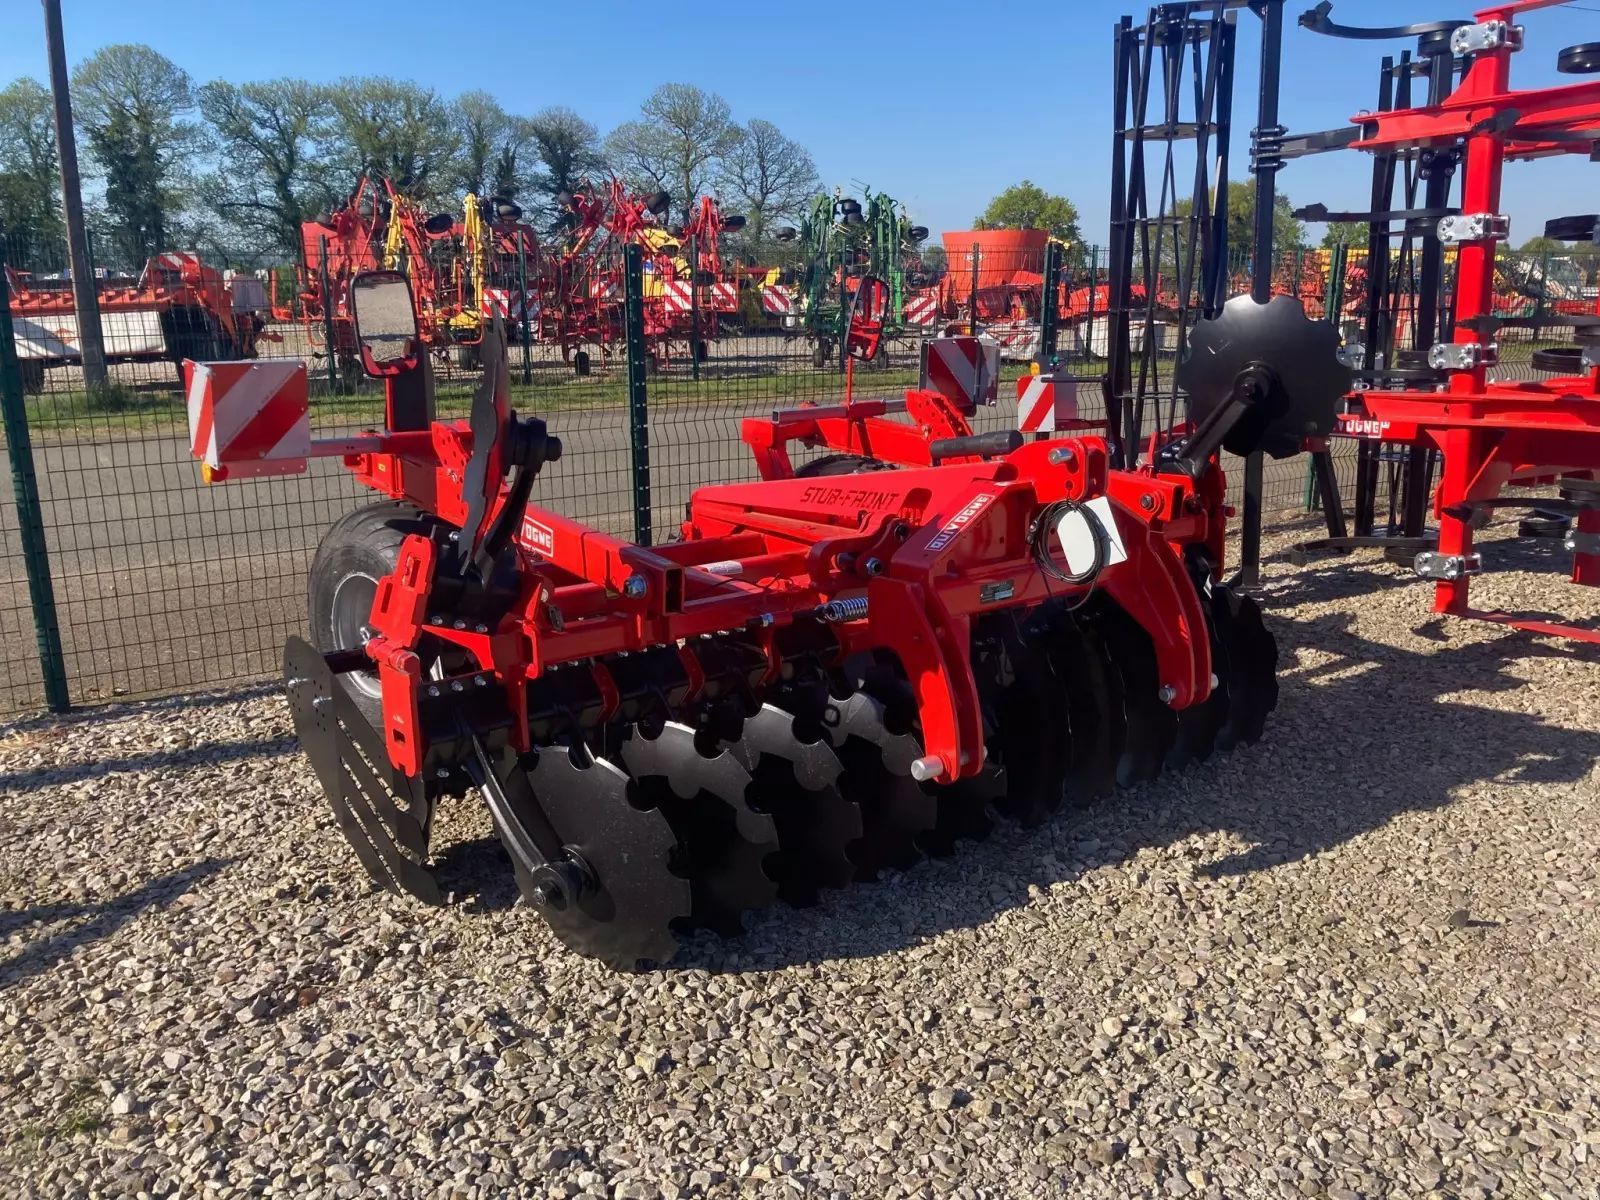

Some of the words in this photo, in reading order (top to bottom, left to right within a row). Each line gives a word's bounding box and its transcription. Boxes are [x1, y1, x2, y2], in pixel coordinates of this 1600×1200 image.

[800, 486, 900, 510] STUB-FRONT
[929, 496, 990, 549] QUIVOGNE
[523, 523, 551, 549] OGNE
